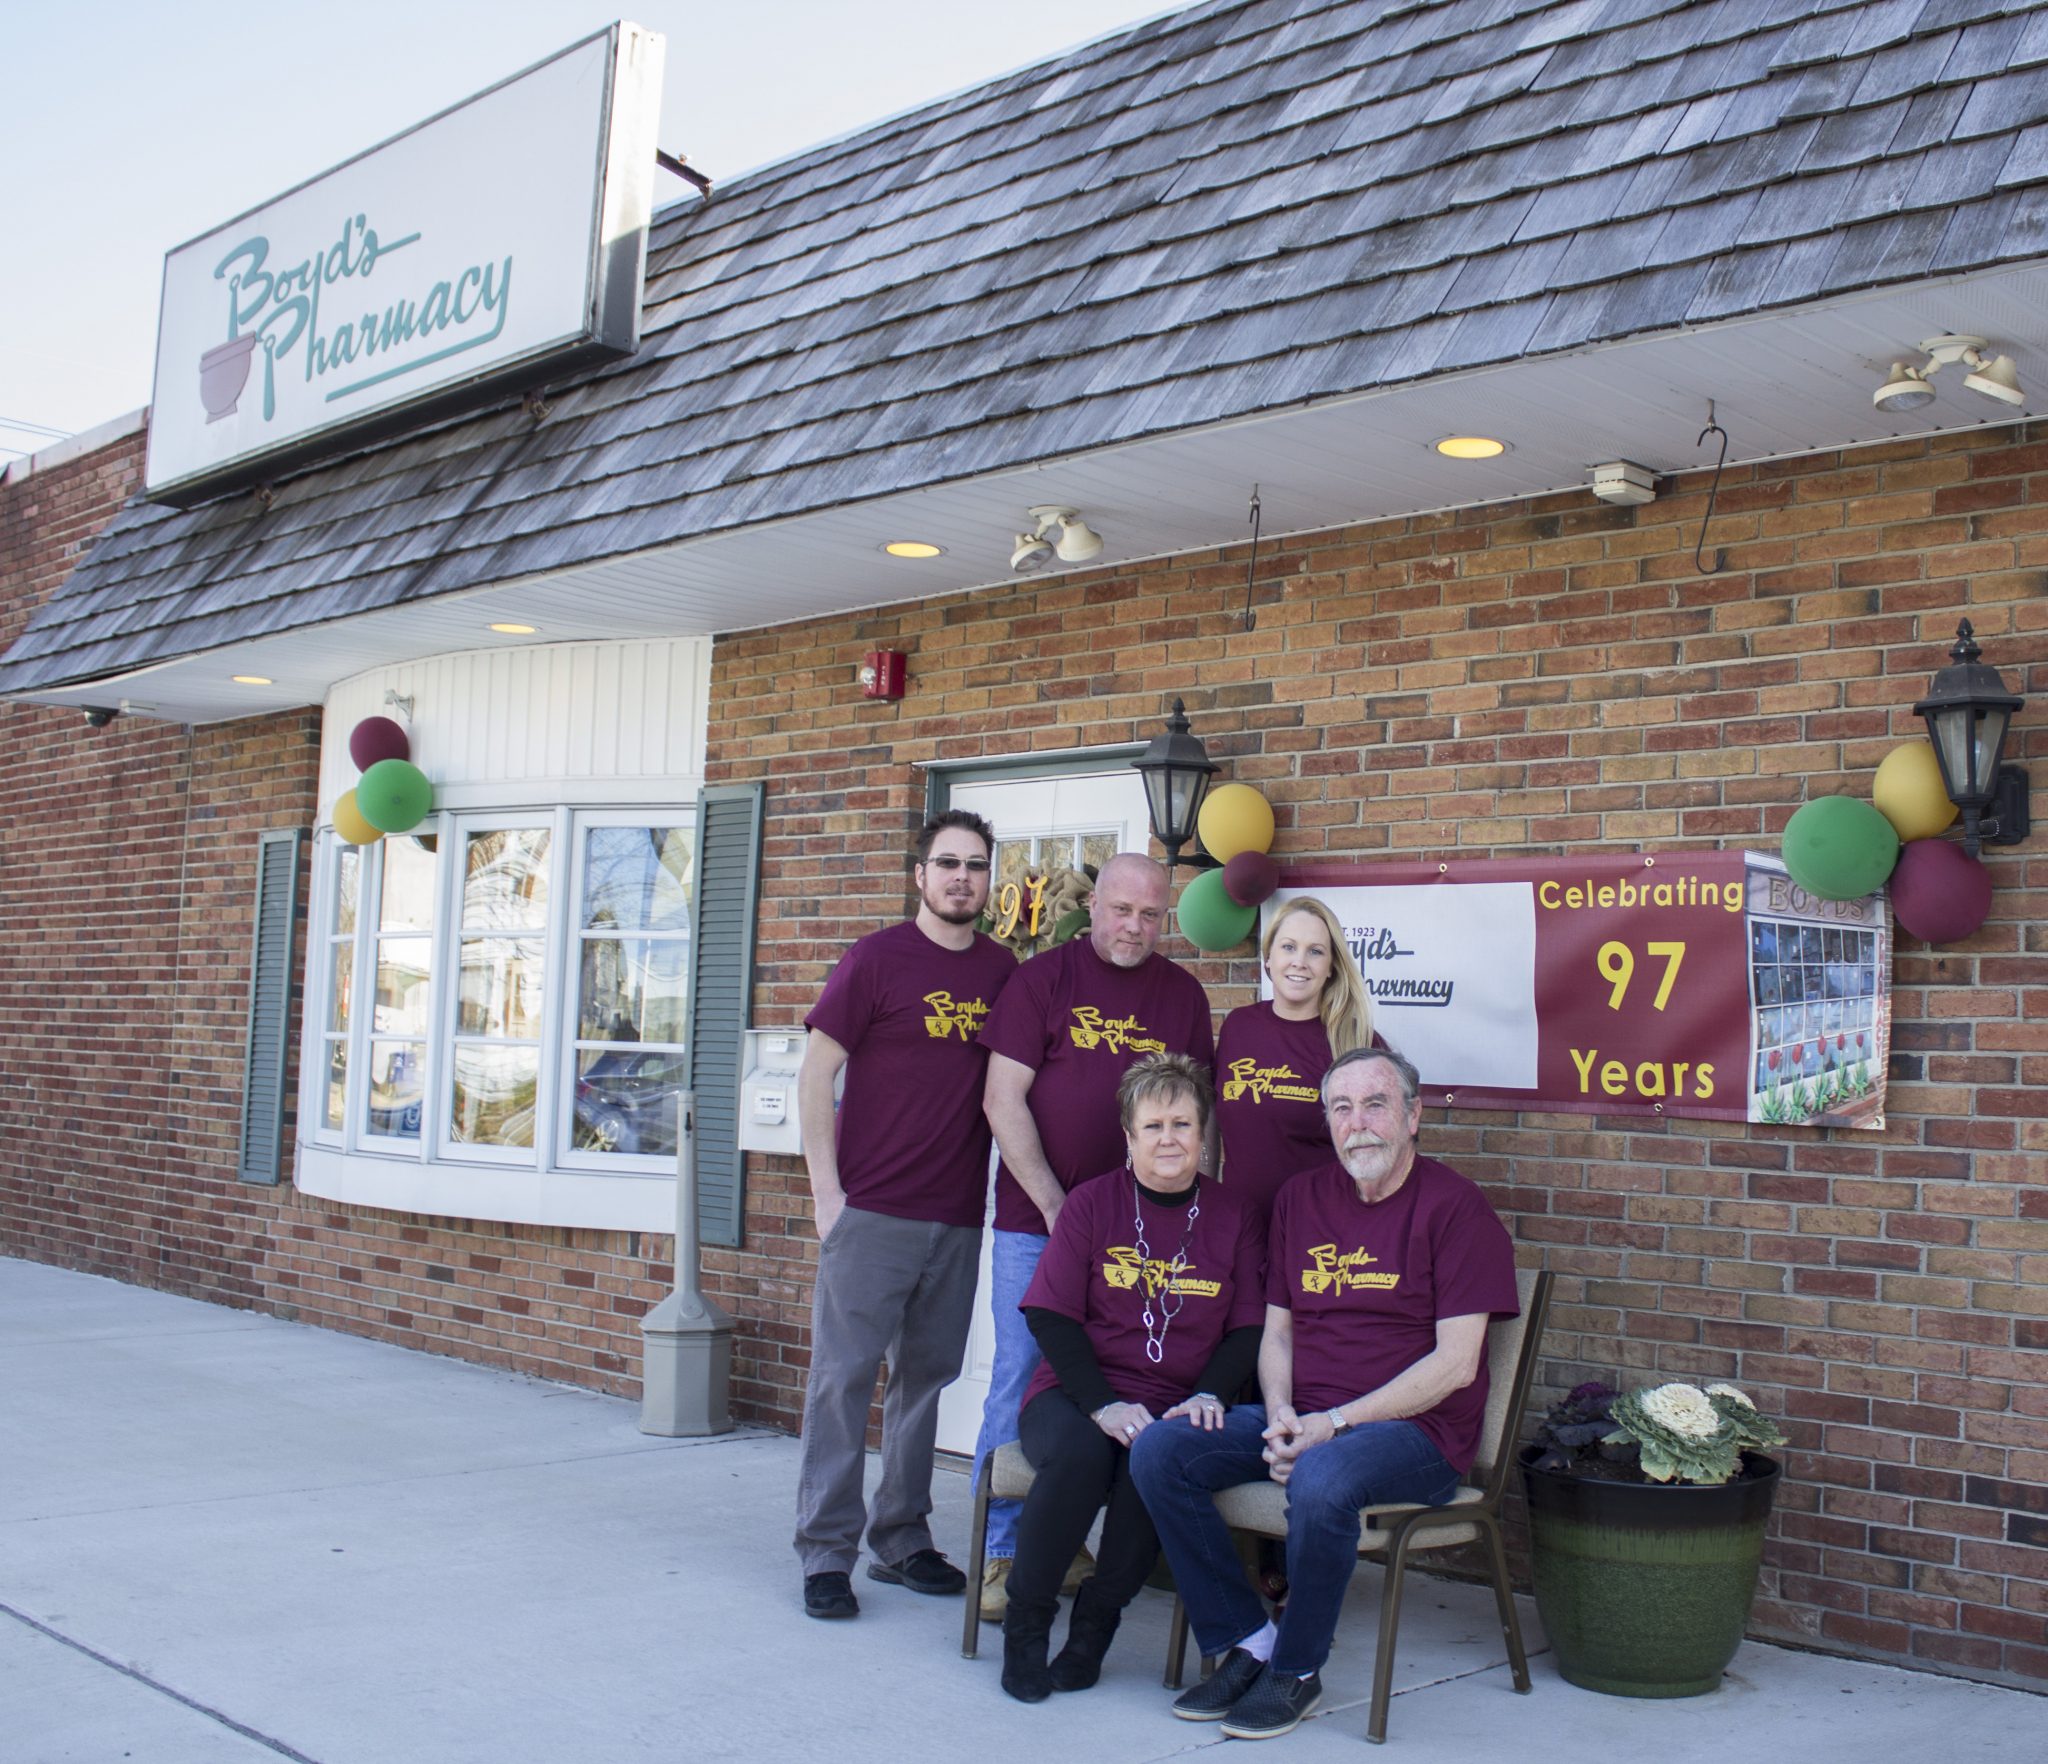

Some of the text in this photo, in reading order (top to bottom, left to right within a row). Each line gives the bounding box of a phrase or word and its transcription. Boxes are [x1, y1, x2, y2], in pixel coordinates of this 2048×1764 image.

[213, 213, 421, 342] Boyd's
[257, 255, 512, 422] Pharmacy
[997, 875, 1049, 938] 97
[1539, 876, 1743, 913] Celebrating
[1352, 927, 1375, 937] 1923
[1365, 978, 1454, 1007] harmacy
[1597, 940, 1686, 1012] 97
[1228, 1057, 1301, 1081] Boyds
[1569, 1048, 1715, 1099] Years
[1333, 1267, 1400, 1297] Pharmacy
